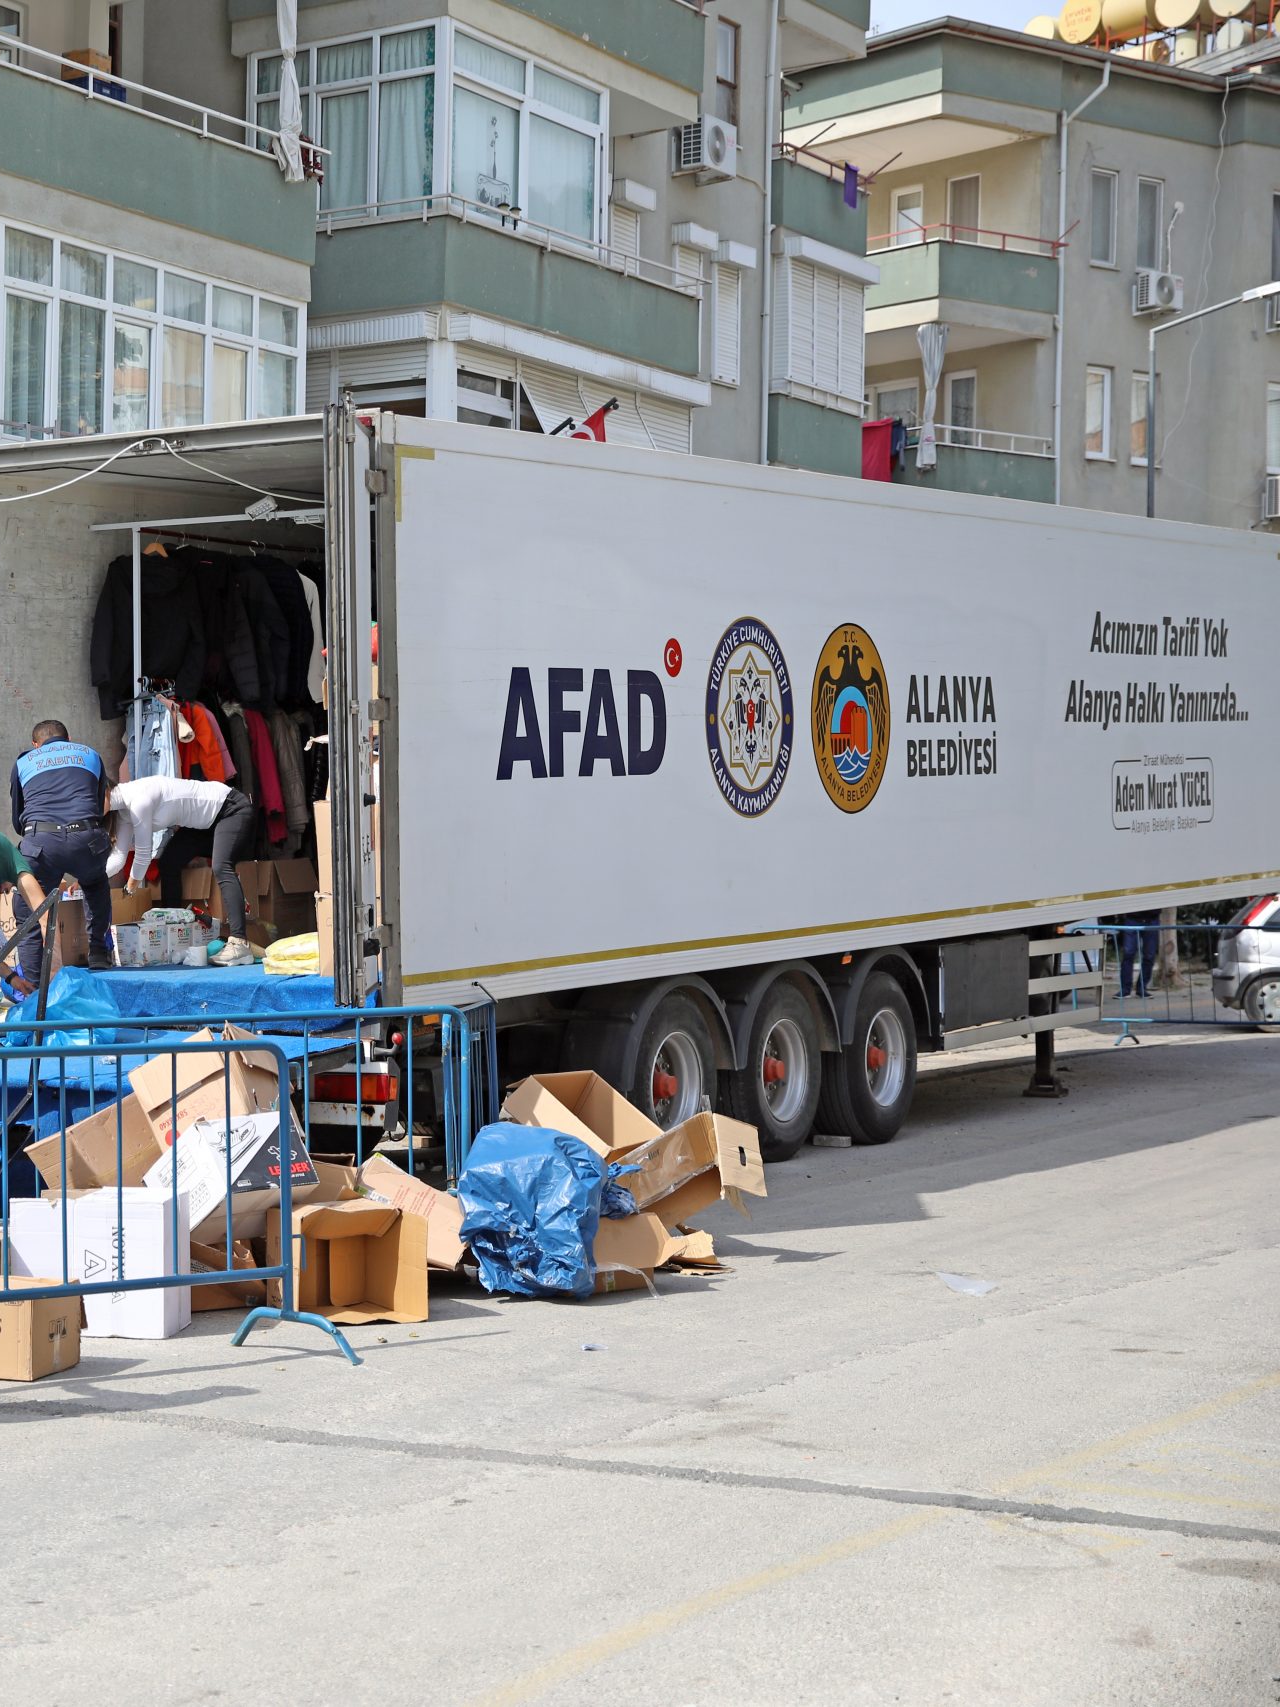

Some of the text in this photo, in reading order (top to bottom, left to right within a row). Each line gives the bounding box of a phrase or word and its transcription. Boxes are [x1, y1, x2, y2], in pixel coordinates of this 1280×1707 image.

[843, 631, 858, 643] T.C.
[1089, 611, 1229, 658] Acımızın Tarifi Yok
[710, 625, 790, 695] TÜRKİYE CUMHURİYETİ
[906, 674, 997, 723] ALANYA
[1064, 680, 1122, 731] Alanya
[1125, 682, 1165, 723] Halkı
[496, 666, 667, 780] AFAD
[710, 748, 736, 806] ALANYA
[820, 756, 846, 799] ALANYA
[906, 730, 998, 778] BELEDİYESİ
[1115, 775, 1144, 812] Adem
[1147, 773, 1178, 810] Murat
[267, 1160, 311, 1177] LEDER
